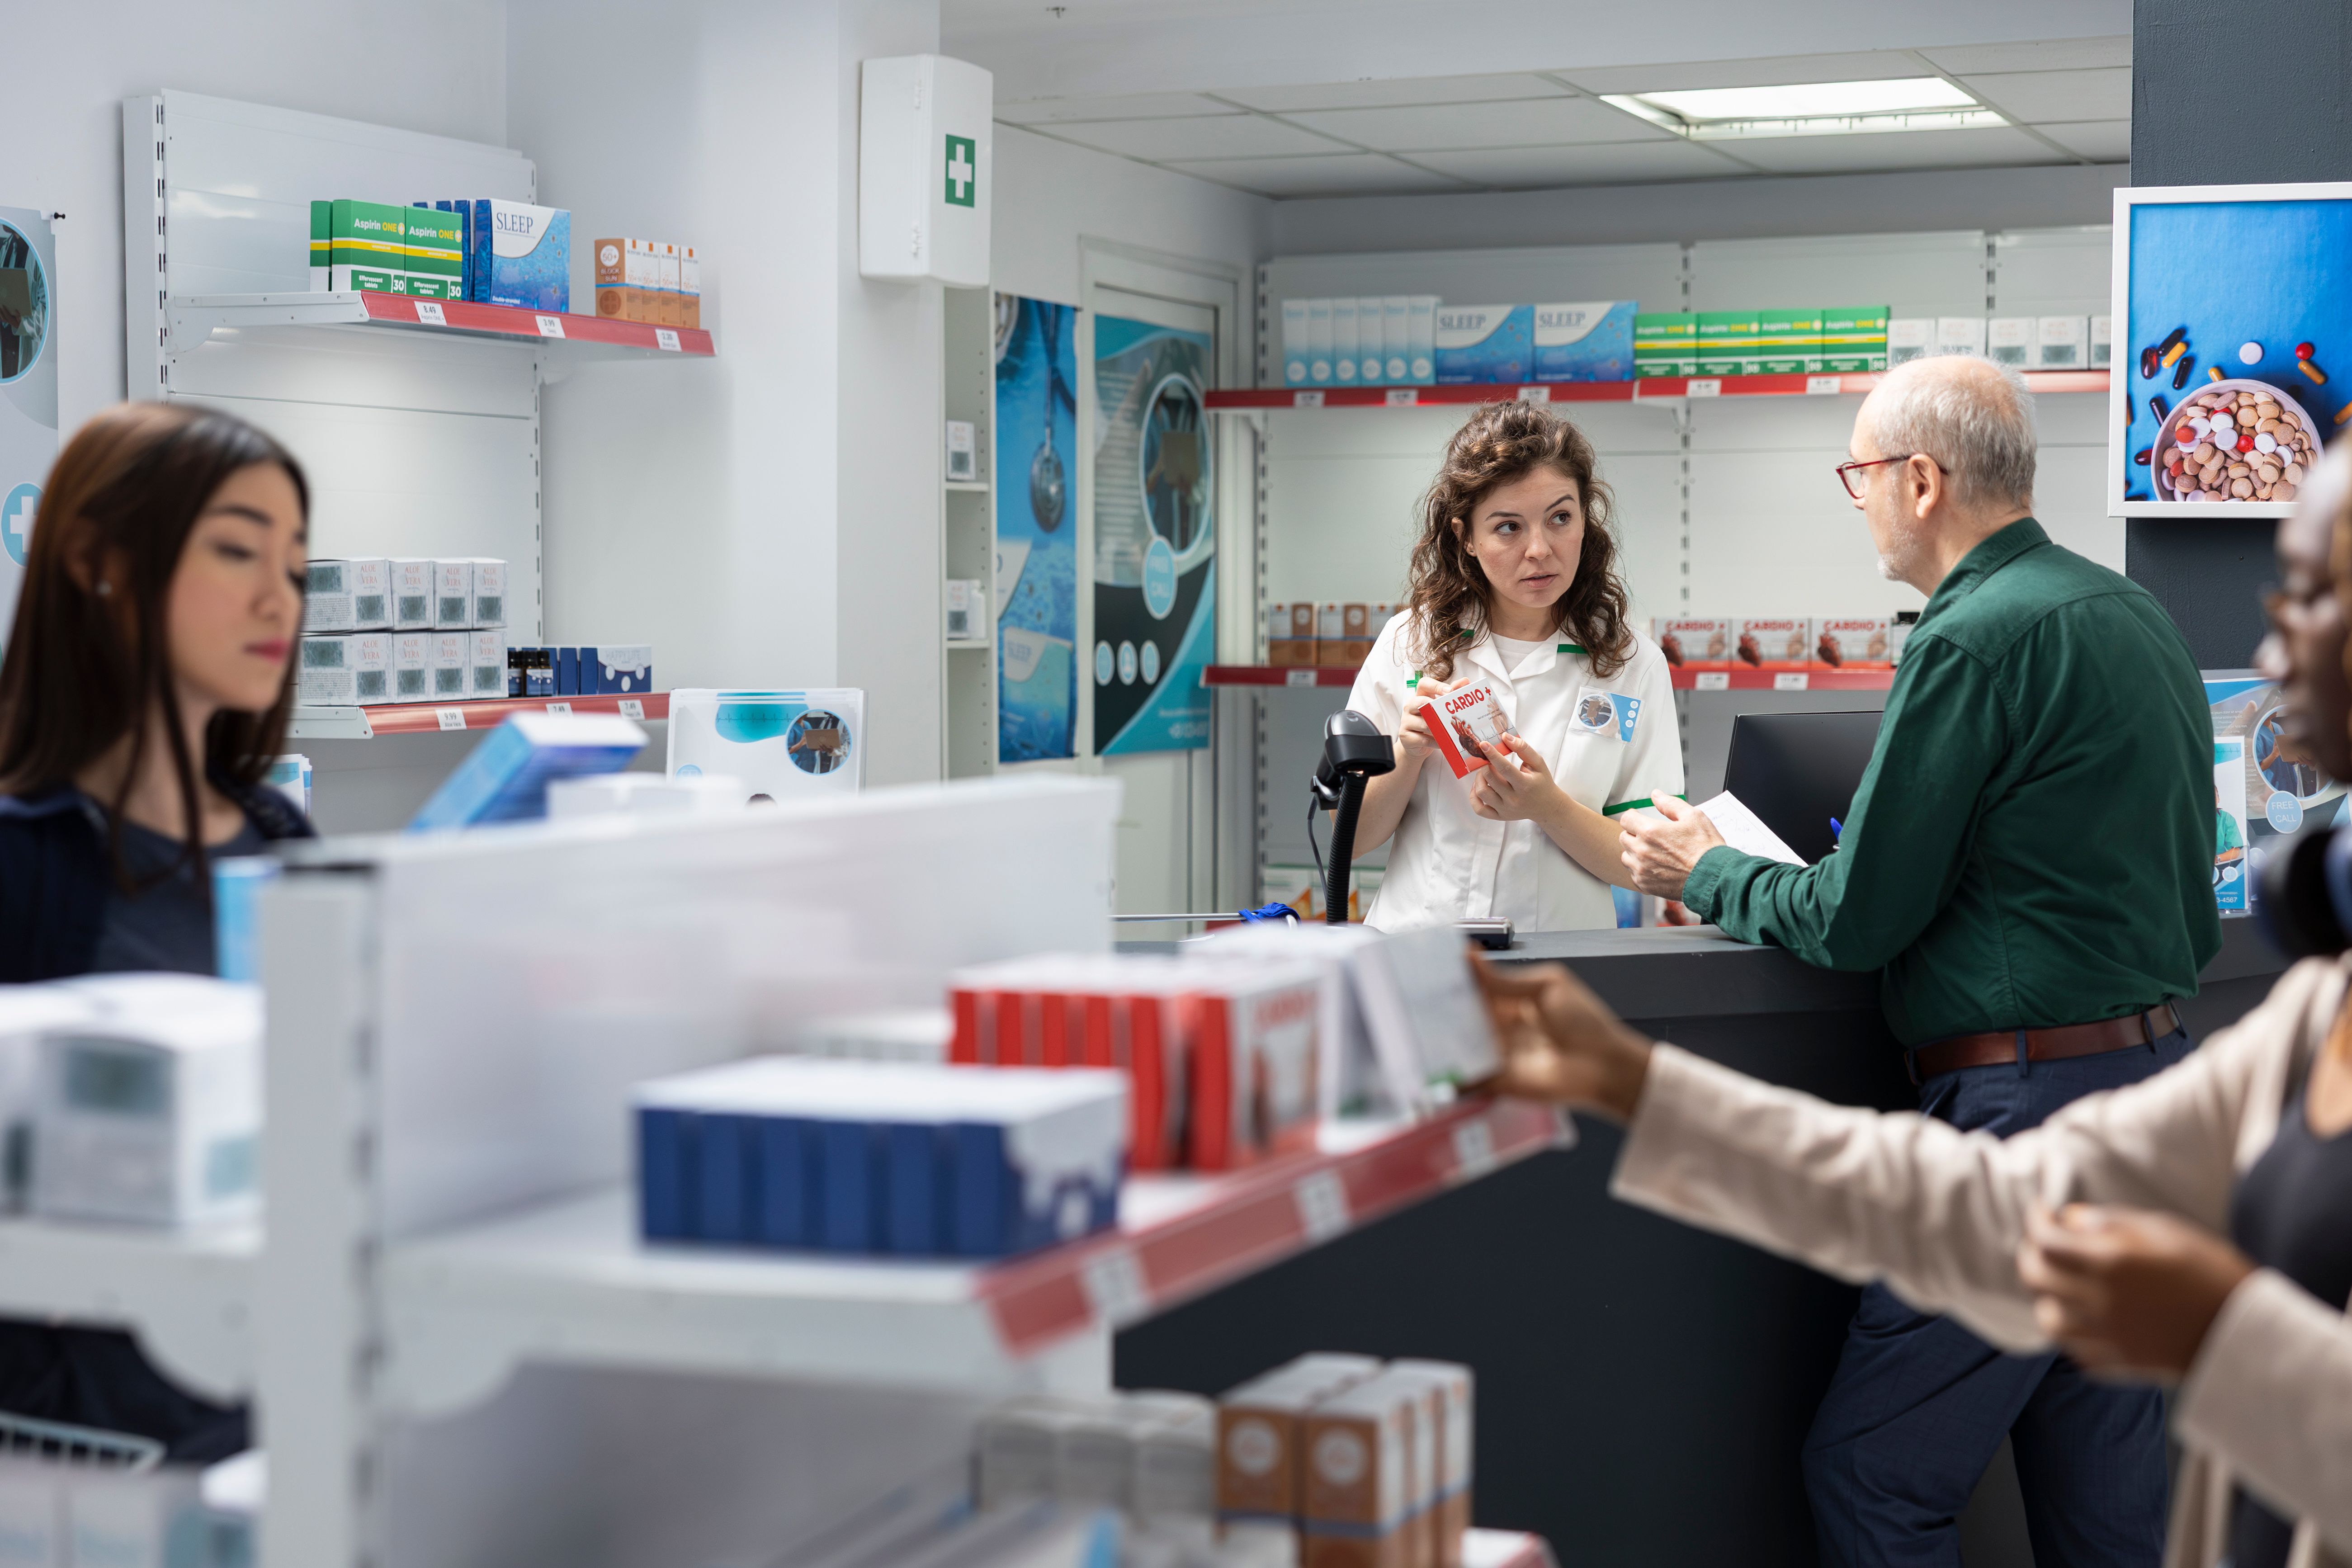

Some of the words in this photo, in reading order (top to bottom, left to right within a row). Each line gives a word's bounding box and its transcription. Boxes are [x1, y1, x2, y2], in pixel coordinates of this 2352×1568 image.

[354, 218, 381, 231] Aspirin
[382, 222, 397, 232] ONE
[496, 212, 534, 234] SLEEP
[409, 226, 437, 238] Aspirin
[438, 229, 454, 240] ONE
[359, 275, 383, 283] Effervescent
[393, 279, 405, 292] 30
[414, 281, 439, 290] Effervescent
[450, 285, 462, 298] 30
[423, 305, 436, 314] 8.49
[361, 564, 376, 573] ALOE
[405, 566, 420, 574] ALOE
[447, 567, 460, 576] ALOE
[362, 576, 378, 584] VERA
[406, 577, 421, 585] VERA
[447, 578, 461, 586] VERA
[484, 578, 497, 586] VERA
[363, 640, 378, 648] ALOE
[403, 639, 419, 647] ALOE
[442, 638, 457, 647] ALOE
[480, 637, 494, 645] ALOE
[363, 651, 380, 660] VERA
[404, 651, 420, 659] VERA
[442, 649, 458, 658] VERA
[480, 648, 496, 656] VERA
[1445, 689, 1484, 714] CARDIO
[2272, 801, 2294, 810] FREE
[2276, 814, 2297, 823] CALL
